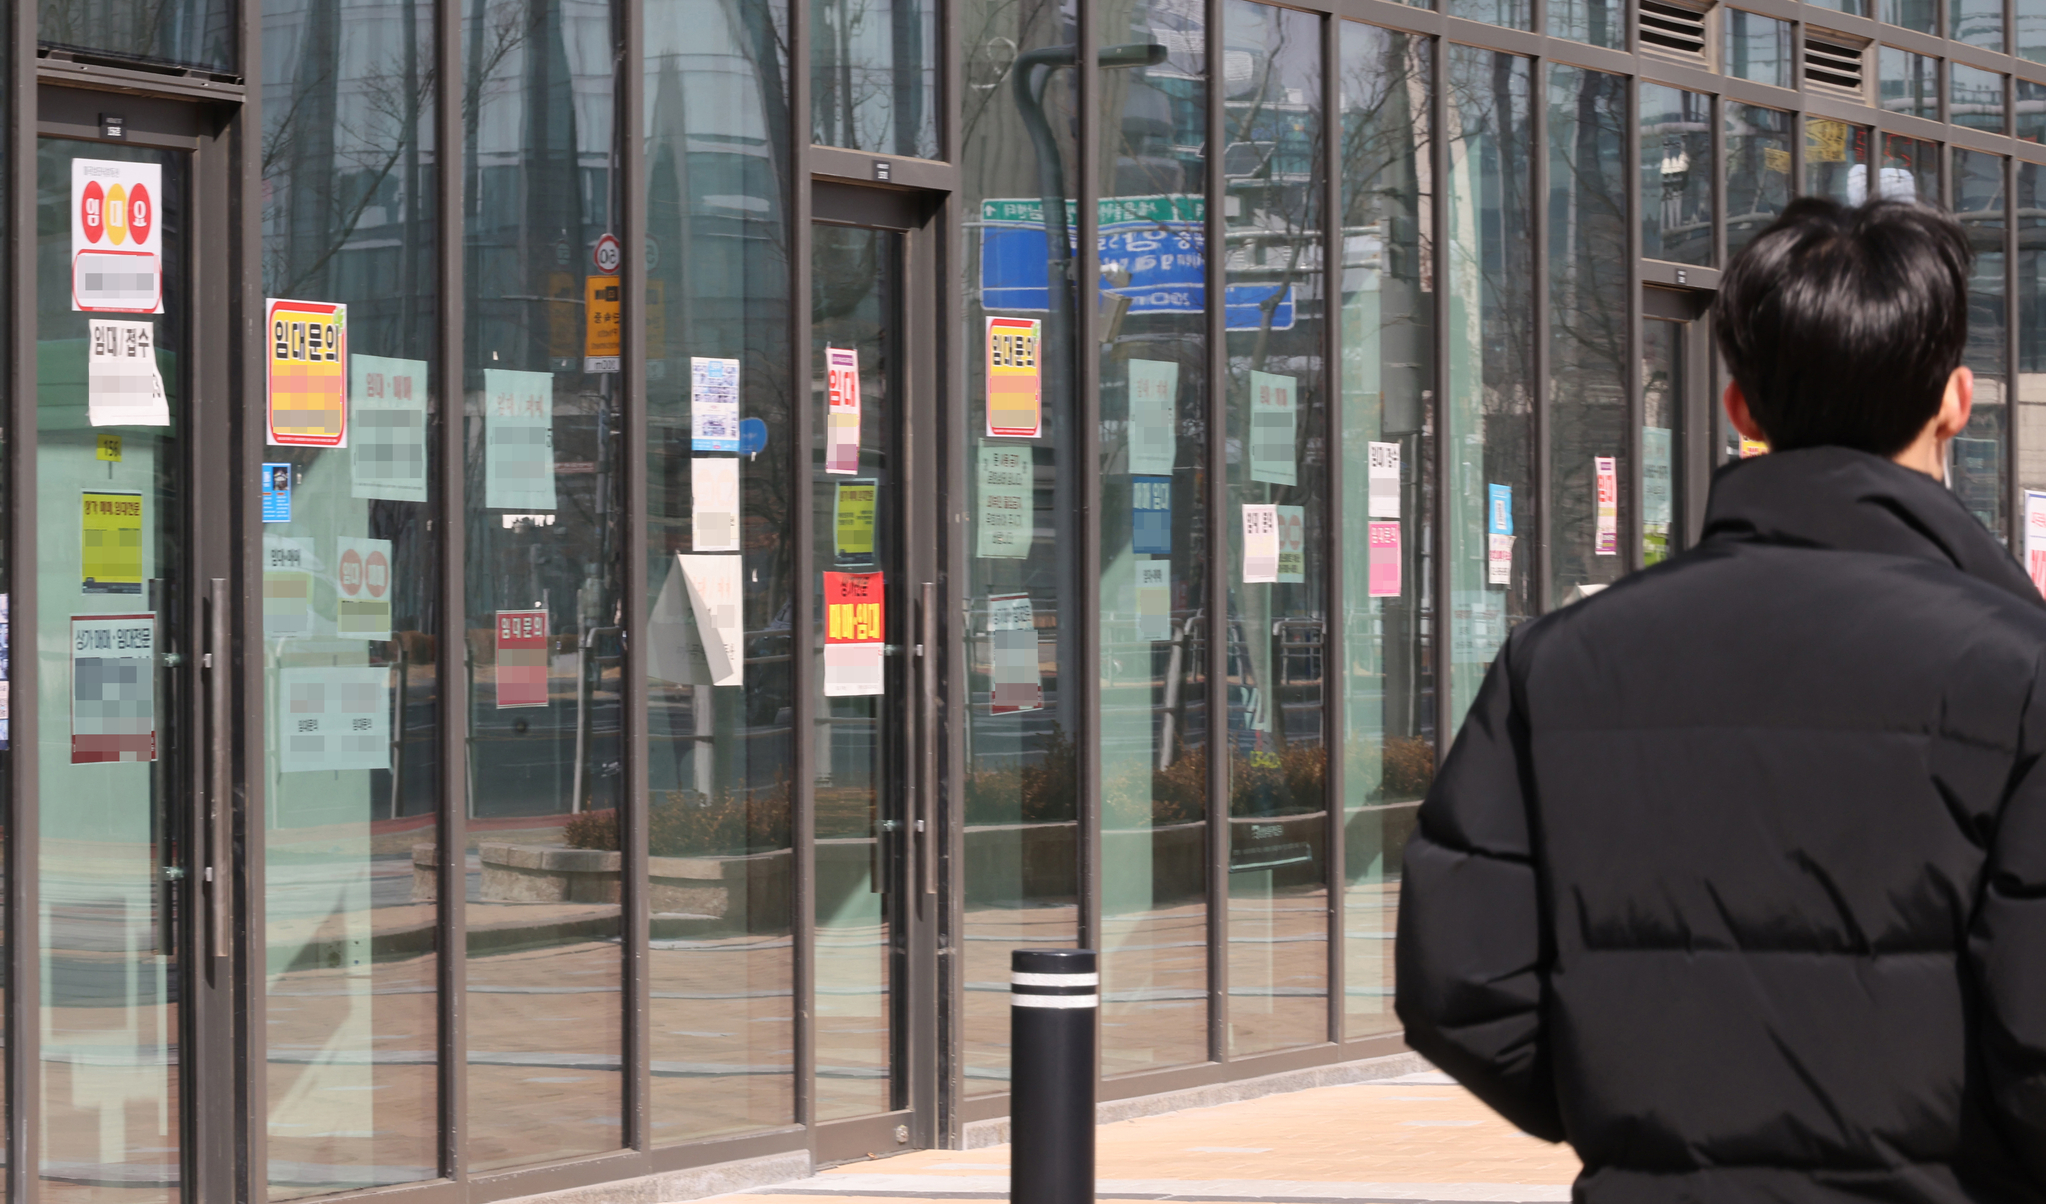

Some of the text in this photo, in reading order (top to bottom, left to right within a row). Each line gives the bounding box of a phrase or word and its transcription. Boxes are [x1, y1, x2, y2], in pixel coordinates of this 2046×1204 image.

[275, 319, 340, 363] 임대문의
[991, 334, 1036, 367] 임대문의
[828, 369, 856, 408] 임대
[75, 630, 94, 650] 상가
[117, 628, 151, 650] 임대전문
[501, 616, 543, 640] 임대문의
